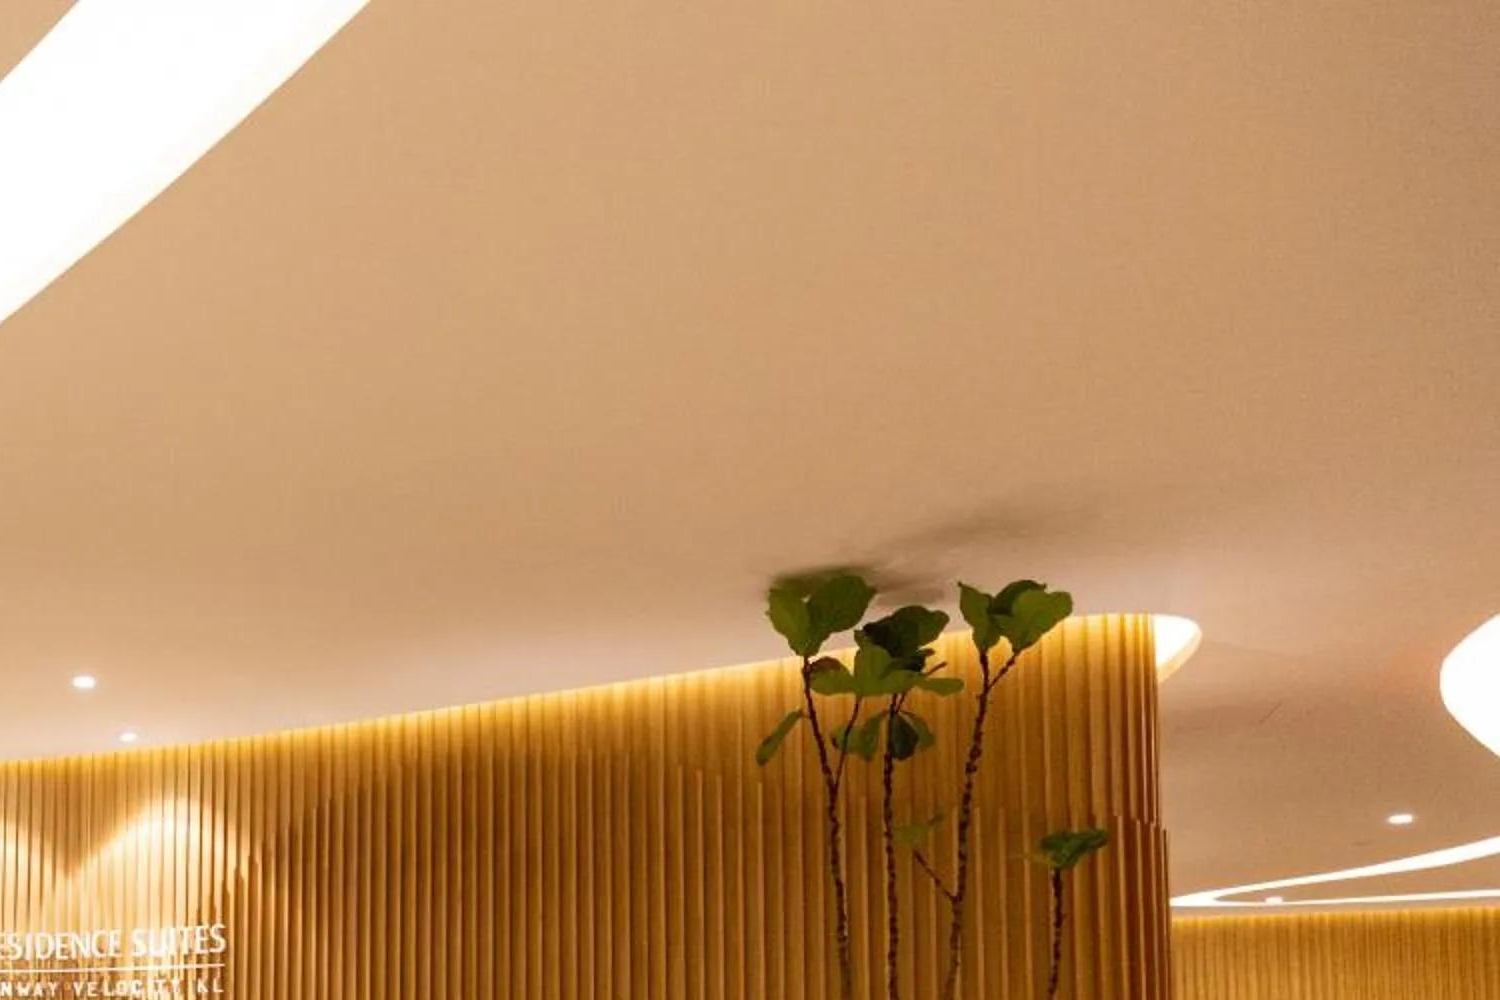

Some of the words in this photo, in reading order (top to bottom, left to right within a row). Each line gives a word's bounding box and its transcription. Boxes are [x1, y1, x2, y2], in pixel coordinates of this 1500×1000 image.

[132, 922, 227, 957] SUITES
[73, 977, 181, 997] VELOCITY
[197, 977, 224, 993] KL
